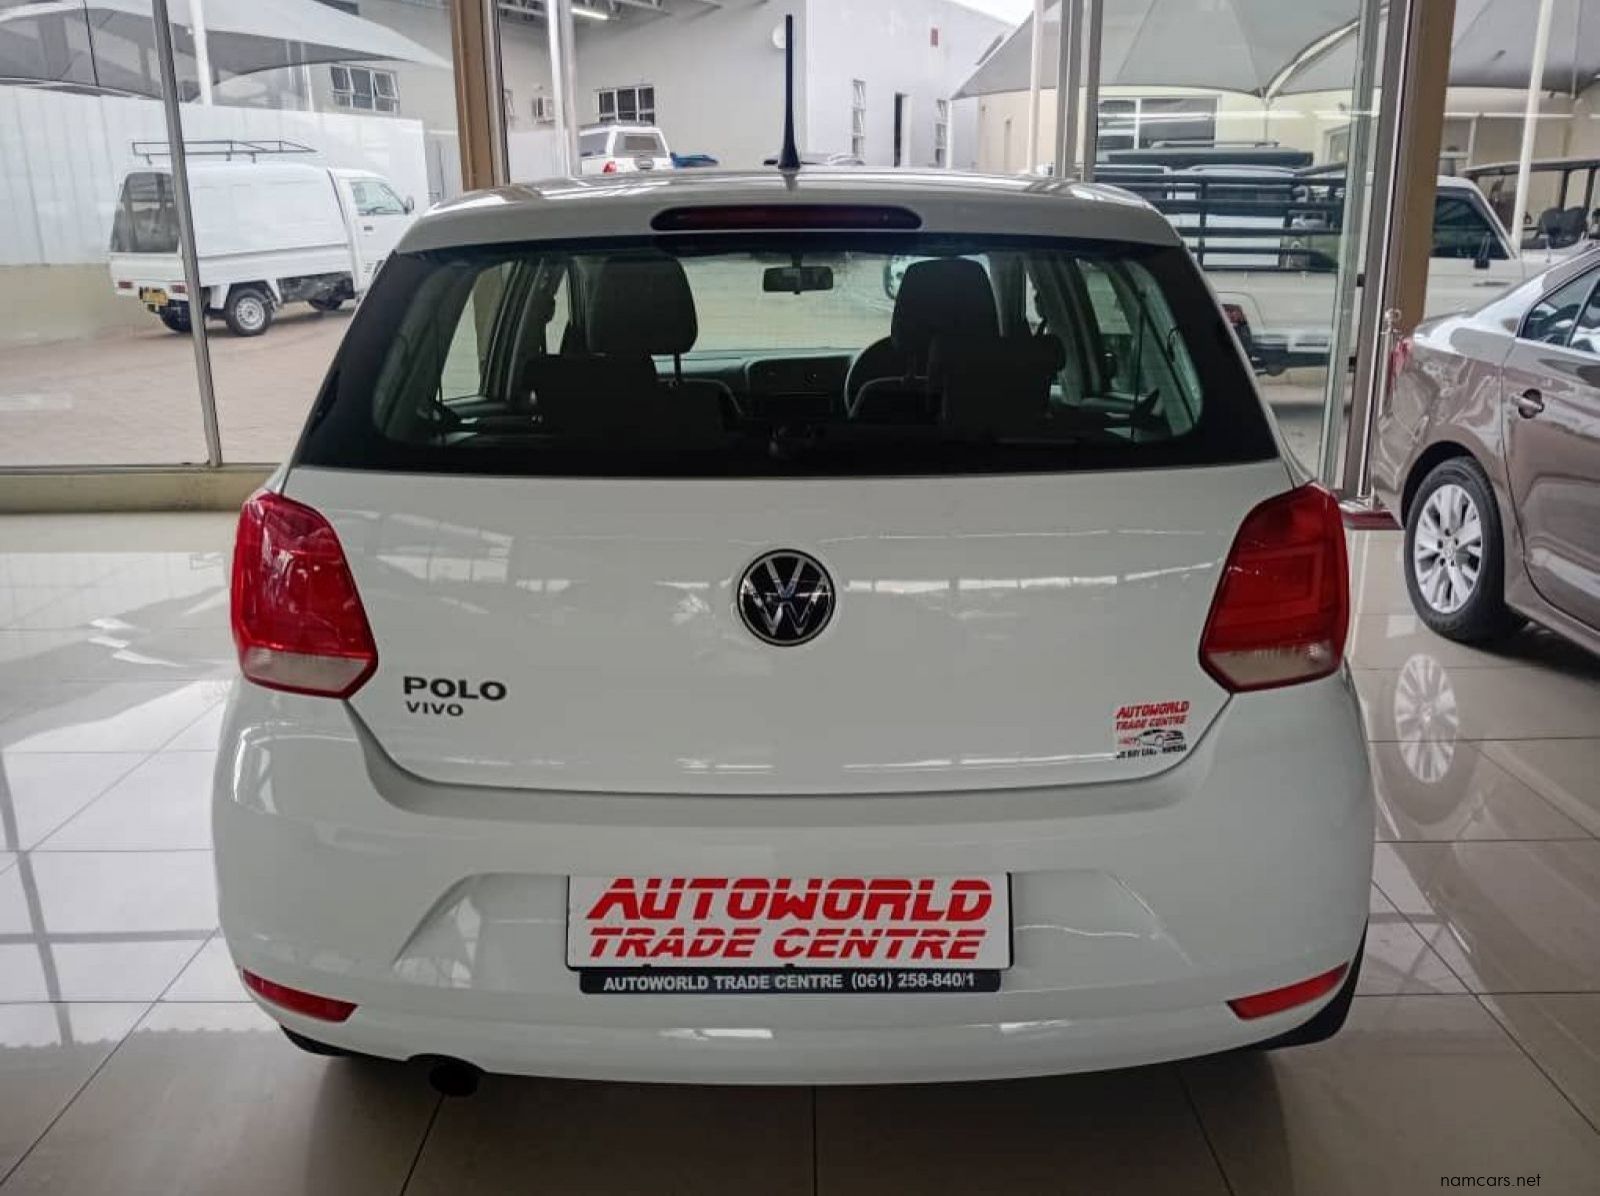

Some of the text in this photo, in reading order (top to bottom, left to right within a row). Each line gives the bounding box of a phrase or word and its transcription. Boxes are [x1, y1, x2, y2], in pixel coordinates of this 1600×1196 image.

[403, 676, 507, 701] POLO
[406, 701, 464, 716] VIVO
[1116, 701, 1190, 719] AUTOWORLD
[586, 878, 992, 921] AUTOWORLD
[589, 927, 986, 960] TRADE CENTRE
[603, 971, 975, 991] AUTOWORLD TRADE CENTRE (061) 258-840/1
